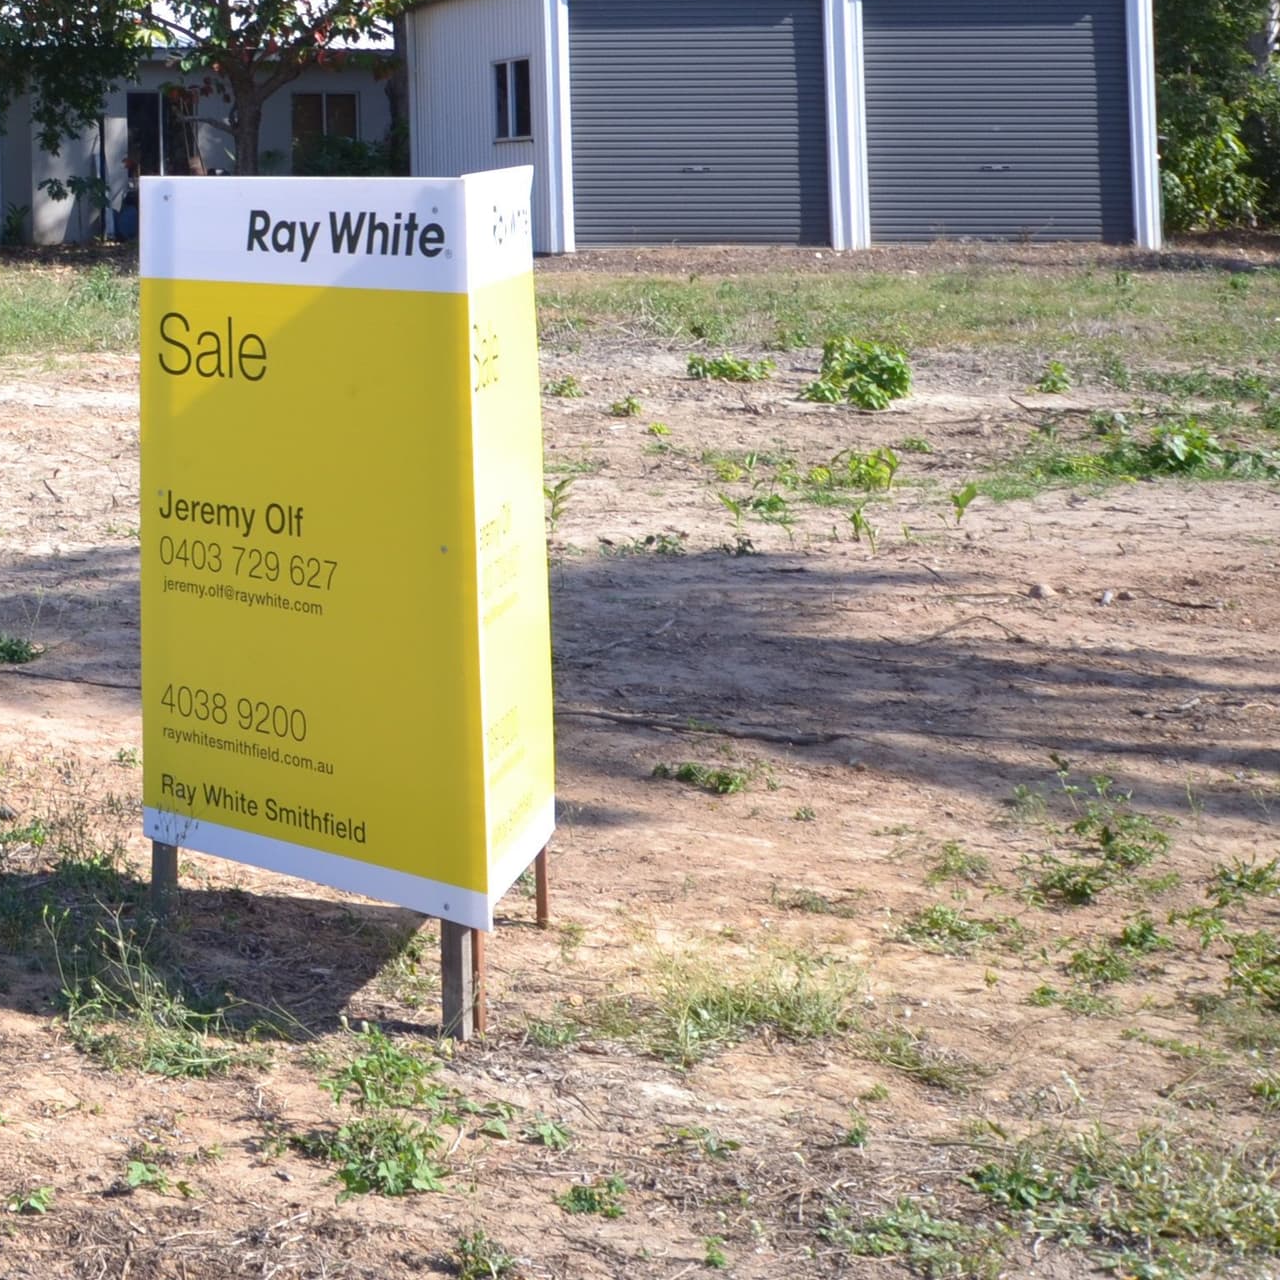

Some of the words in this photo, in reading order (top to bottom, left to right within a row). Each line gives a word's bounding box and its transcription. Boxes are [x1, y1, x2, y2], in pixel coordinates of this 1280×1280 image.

[246, 209, 321, 262] Ray
[329, 211, 445, 258] White
[158, 312, 267, 382] Sale
[159, 490, 255, 537] Jeremy
[265, 503, 304, 537] Olf
[159, 535, 223, 572] 0403
[232, 546, 280, 582] 729
[290, 555, 338, 591] 627
[163, 576, 323, 615] jeremy.olf@raywhite.com
[160, 683, 228, 725] 4038
[237, 698, 307, 742] 9200
[163, 726, 334, 775] raywhitesmithfield.com.au
[161, 773, 197, 806] Ray
[202, 782, 258, 817] White
[265, 798, 366, 844] Smithfield
